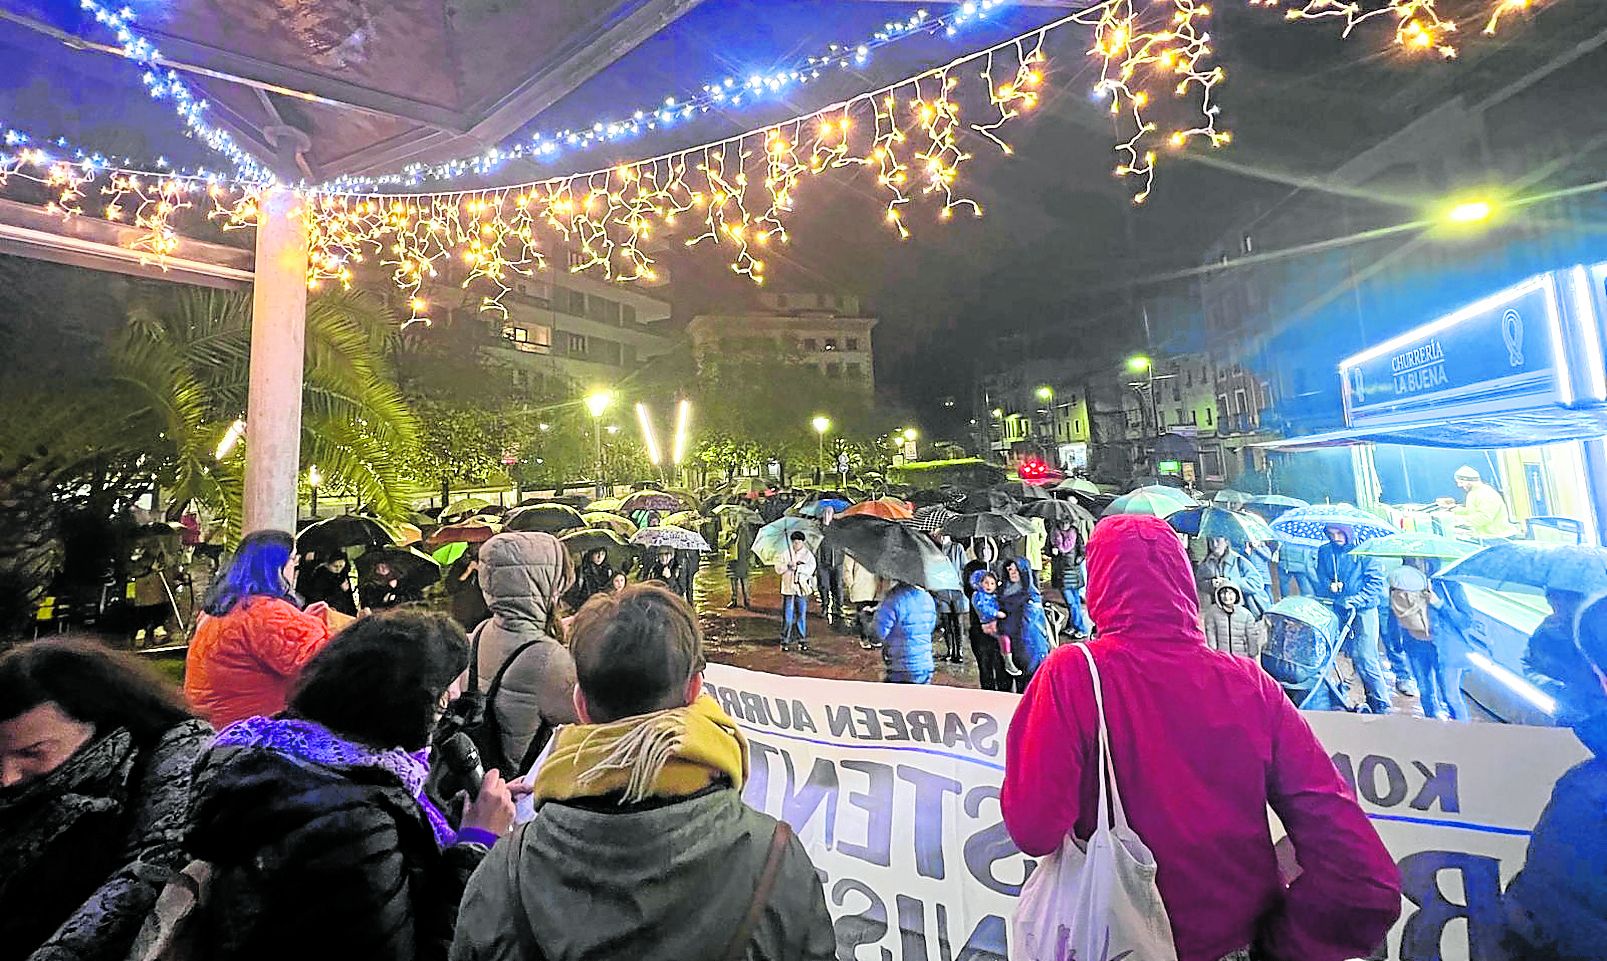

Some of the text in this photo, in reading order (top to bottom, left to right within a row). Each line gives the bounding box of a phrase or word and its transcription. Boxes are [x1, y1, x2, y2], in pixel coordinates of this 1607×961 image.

[1392, 338, 1444, 371] CHURRERÍA
[1394, 364, 1449, 394] LA BUENA
